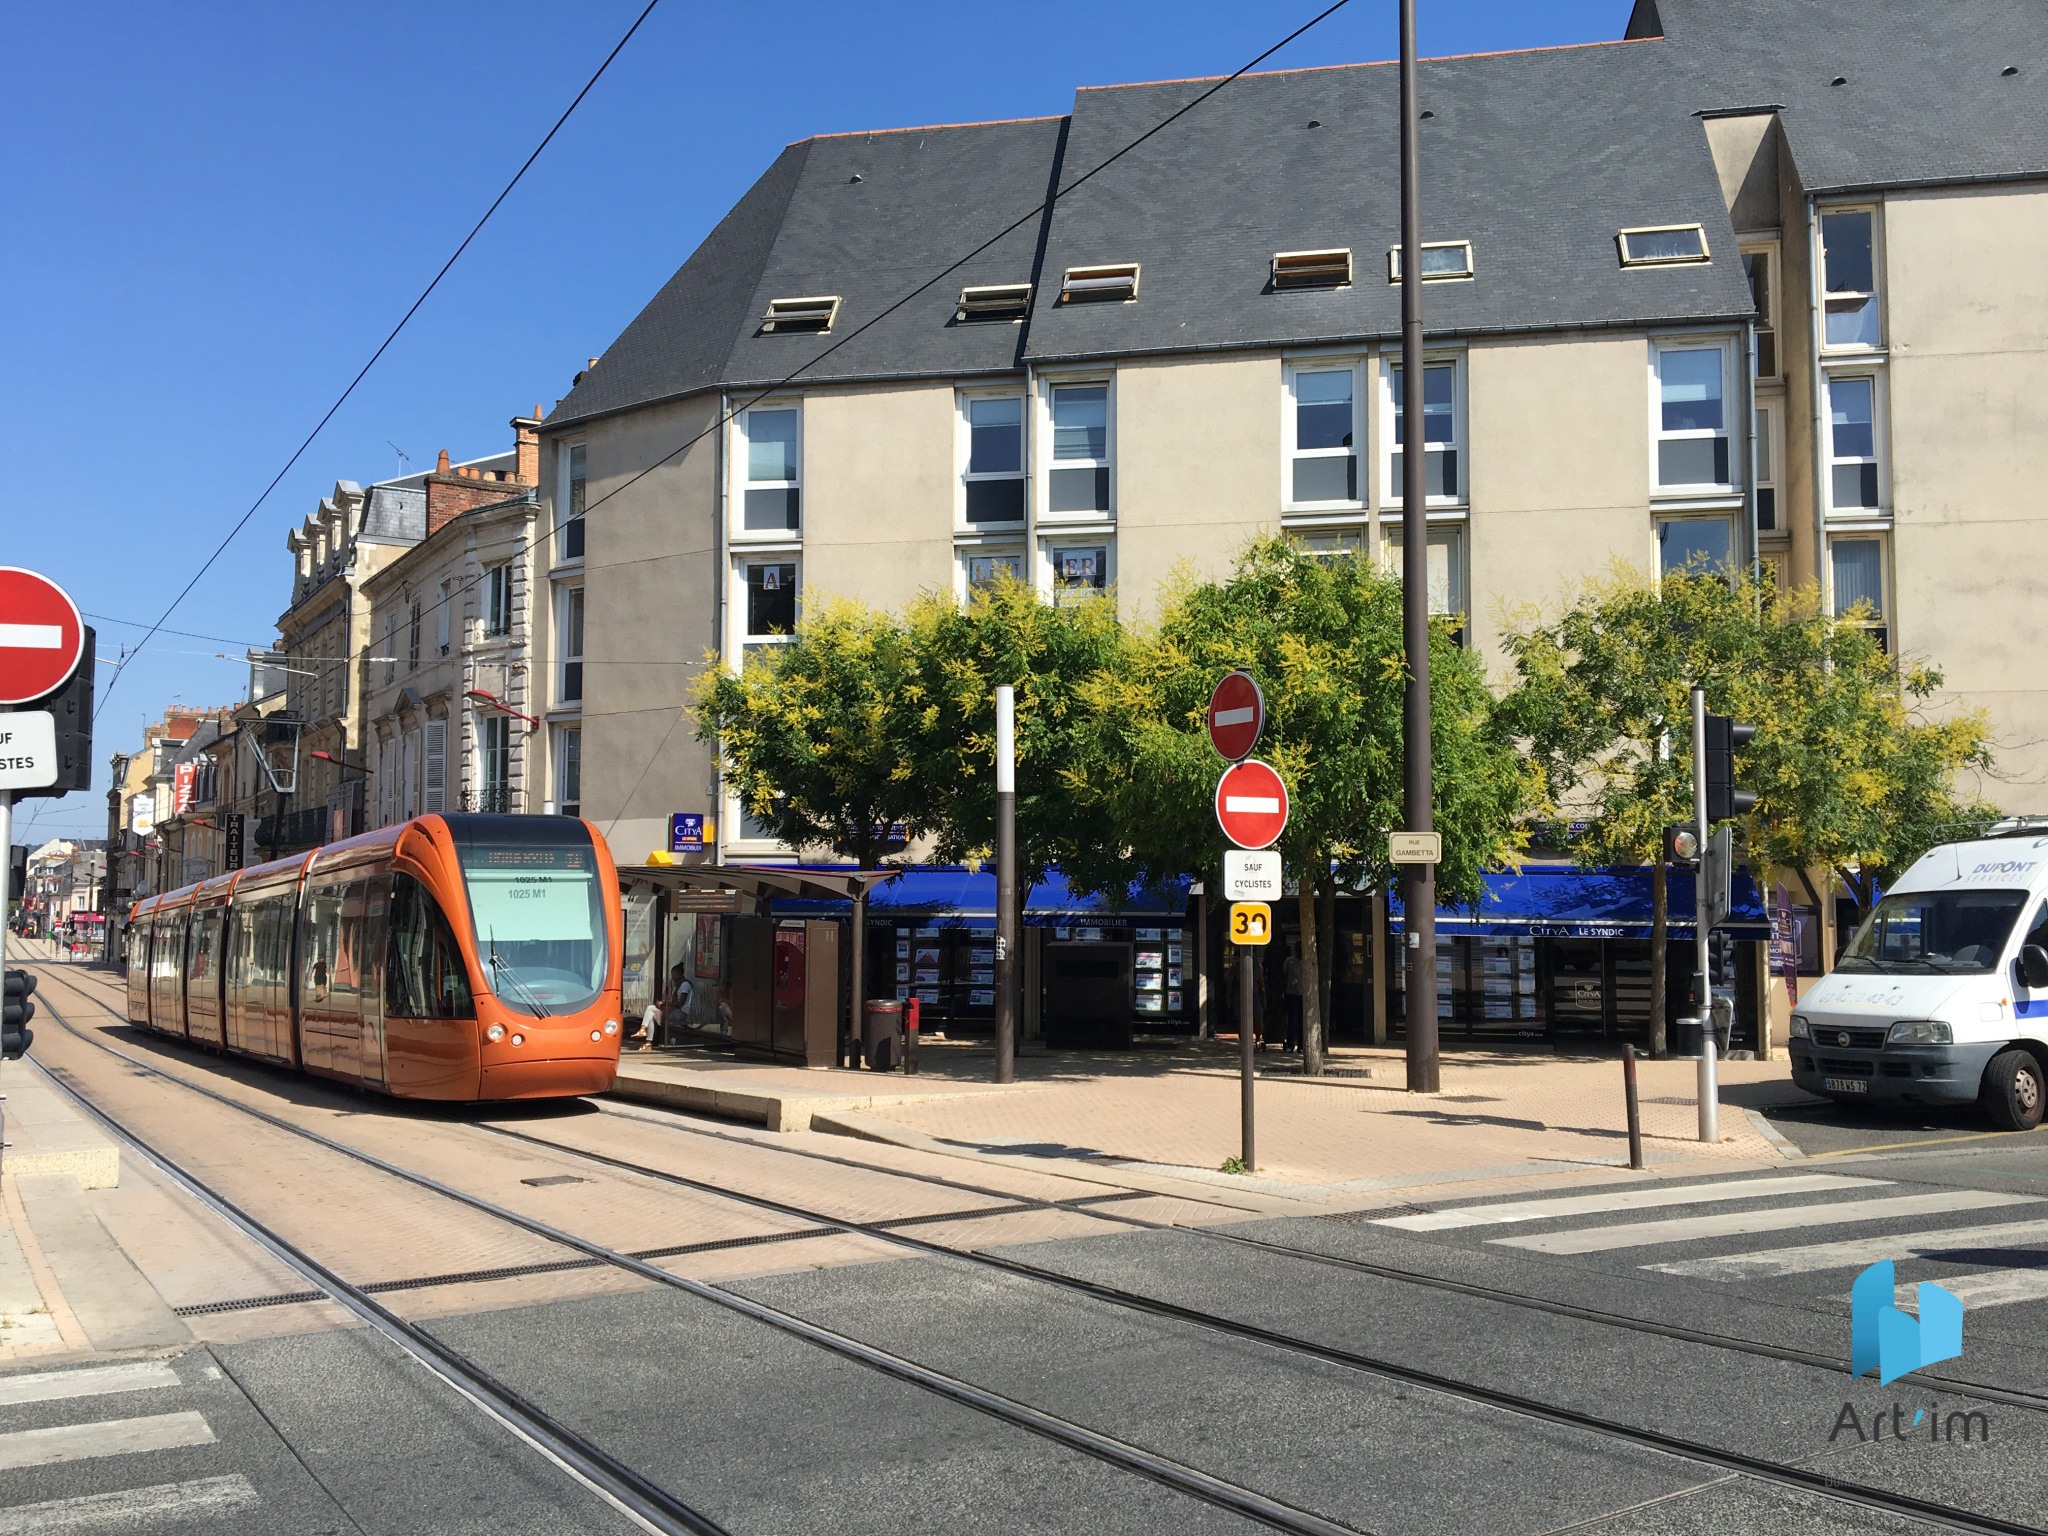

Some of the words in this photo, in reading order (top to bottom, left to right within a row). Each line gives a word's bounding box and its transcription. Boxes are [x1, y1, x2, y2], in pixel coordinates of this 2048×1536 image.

[765, 572, 779, 588] A
[178, 765, 193, 813] PIZZA
[229, 815, 239, 869] TRAITEUR
[1395, 849, 1435, 857] GAMBETTA
[1244, 863, 1263, 872] SAUF
[1971, 860, 2038, 875] DUPONT
[1964, 873, 2025, 883] SERVICES
[1234, 880, 1272, 889] CYCLISTES
[507, 889, 531, 900] 1025
[532, 888, 547, 898] M1
[1080, 918, 1128, 927] IMMOBILIER
[1578, 927, 1589, 936] LE
[1590, 928, 1624, 937] SYNDIC
